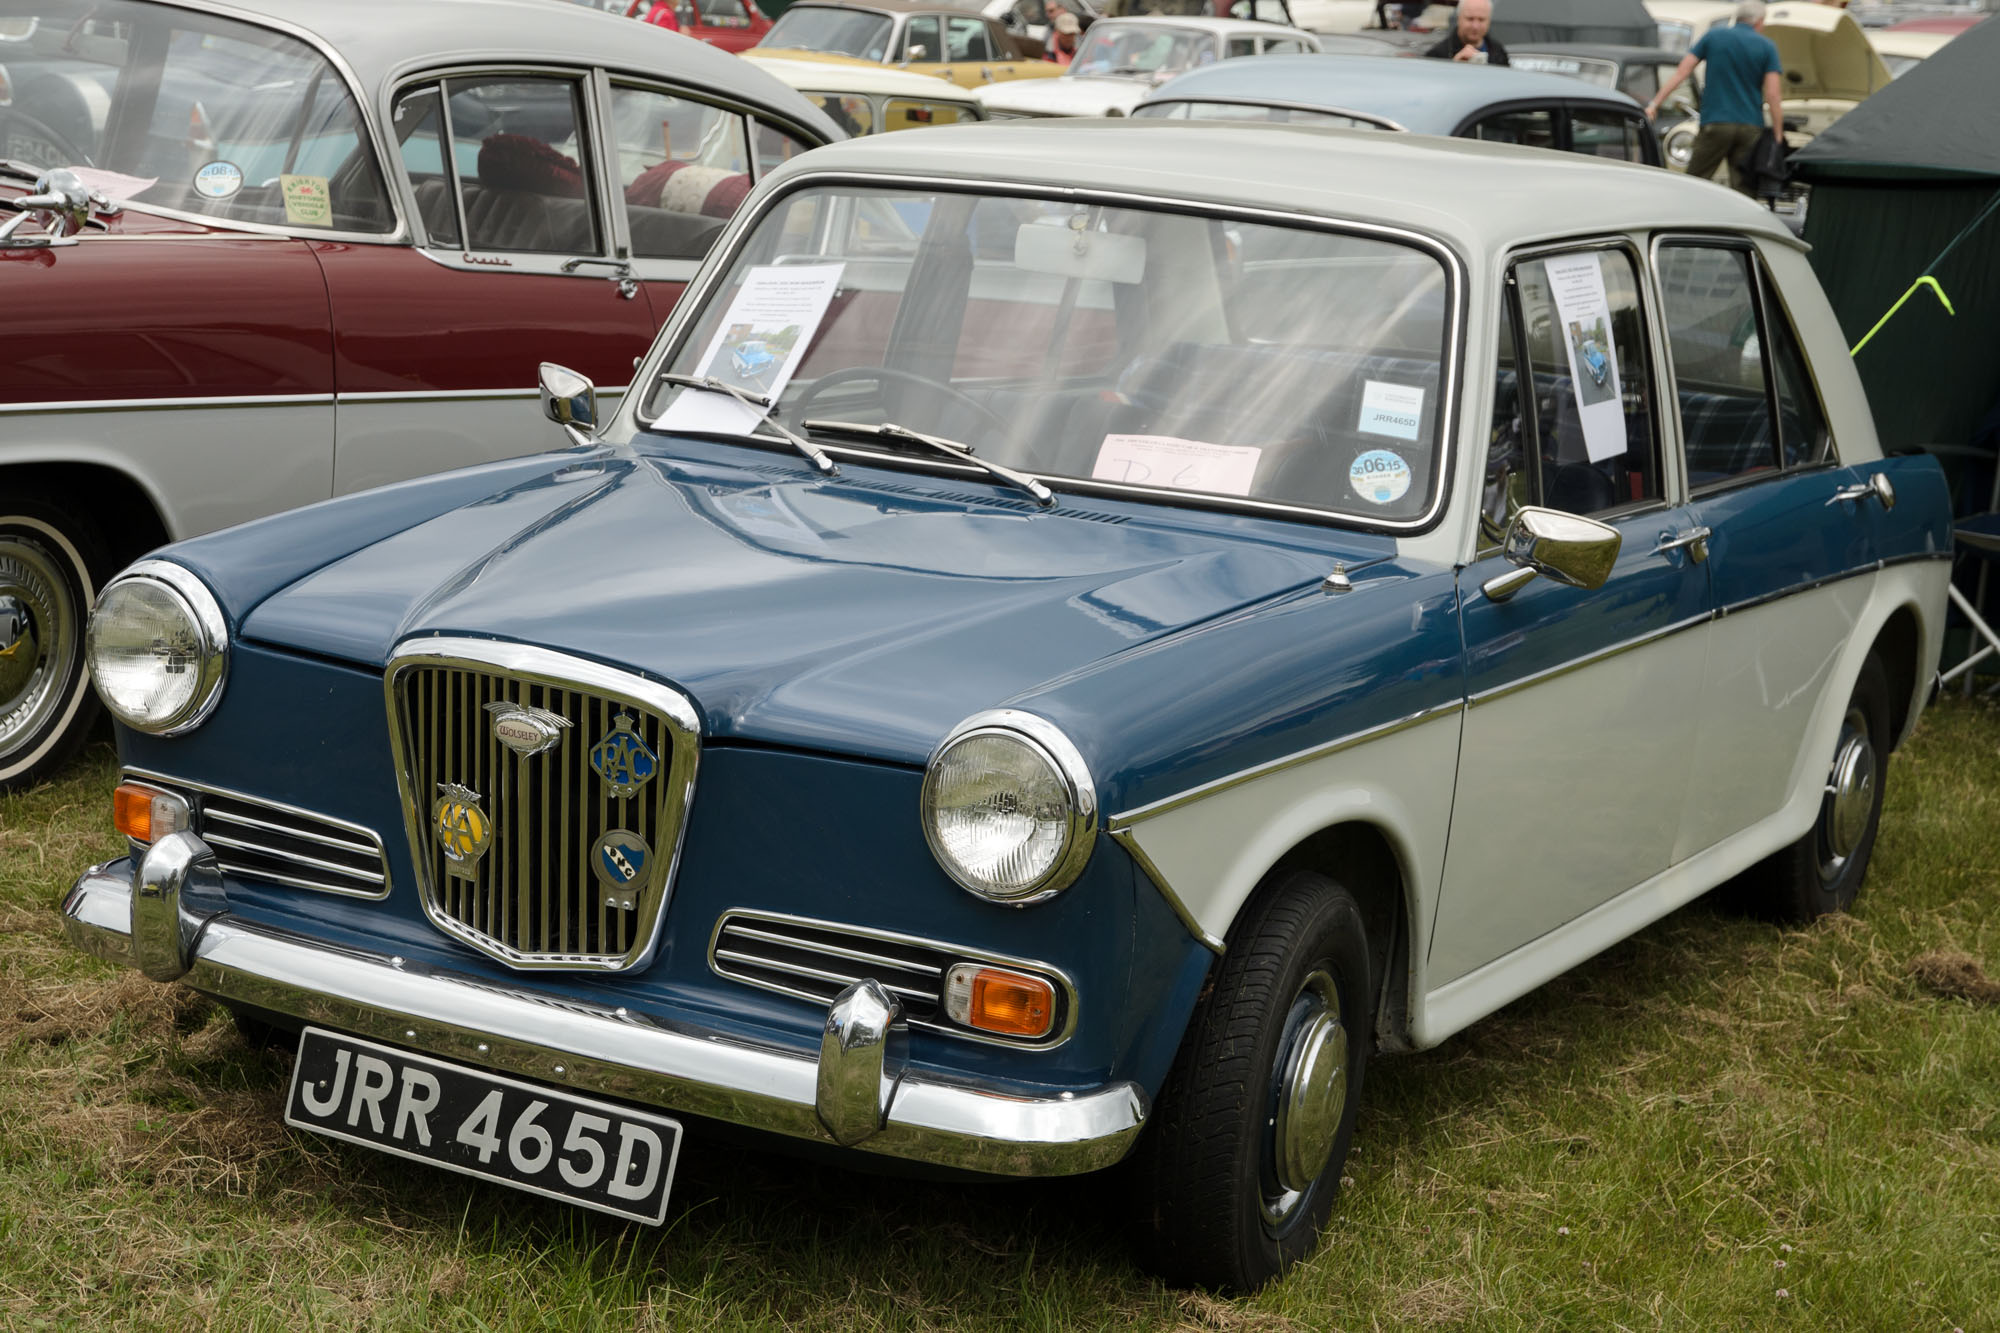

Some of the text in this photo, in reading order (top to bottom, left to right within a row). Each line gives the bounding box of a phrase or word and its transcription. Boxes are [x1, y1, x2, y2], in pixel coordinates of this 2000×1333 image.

[300, 209, 319, 217] CLUB
[1373, 413, 1416, 427] JRR465D
[1352, 466, 1364, 475] 30
[1364, 457, 1386, 474] 06
[1387, 459, 1401, 472] 15
[498, 725, 540, 742] WOLSELEY
[600, 736, 648, 785] RAC
[441, 801, 478, 861] AA
[609, 847, 633, 877] BMC
[301, 1048, 663, 1202] JRR 465D
